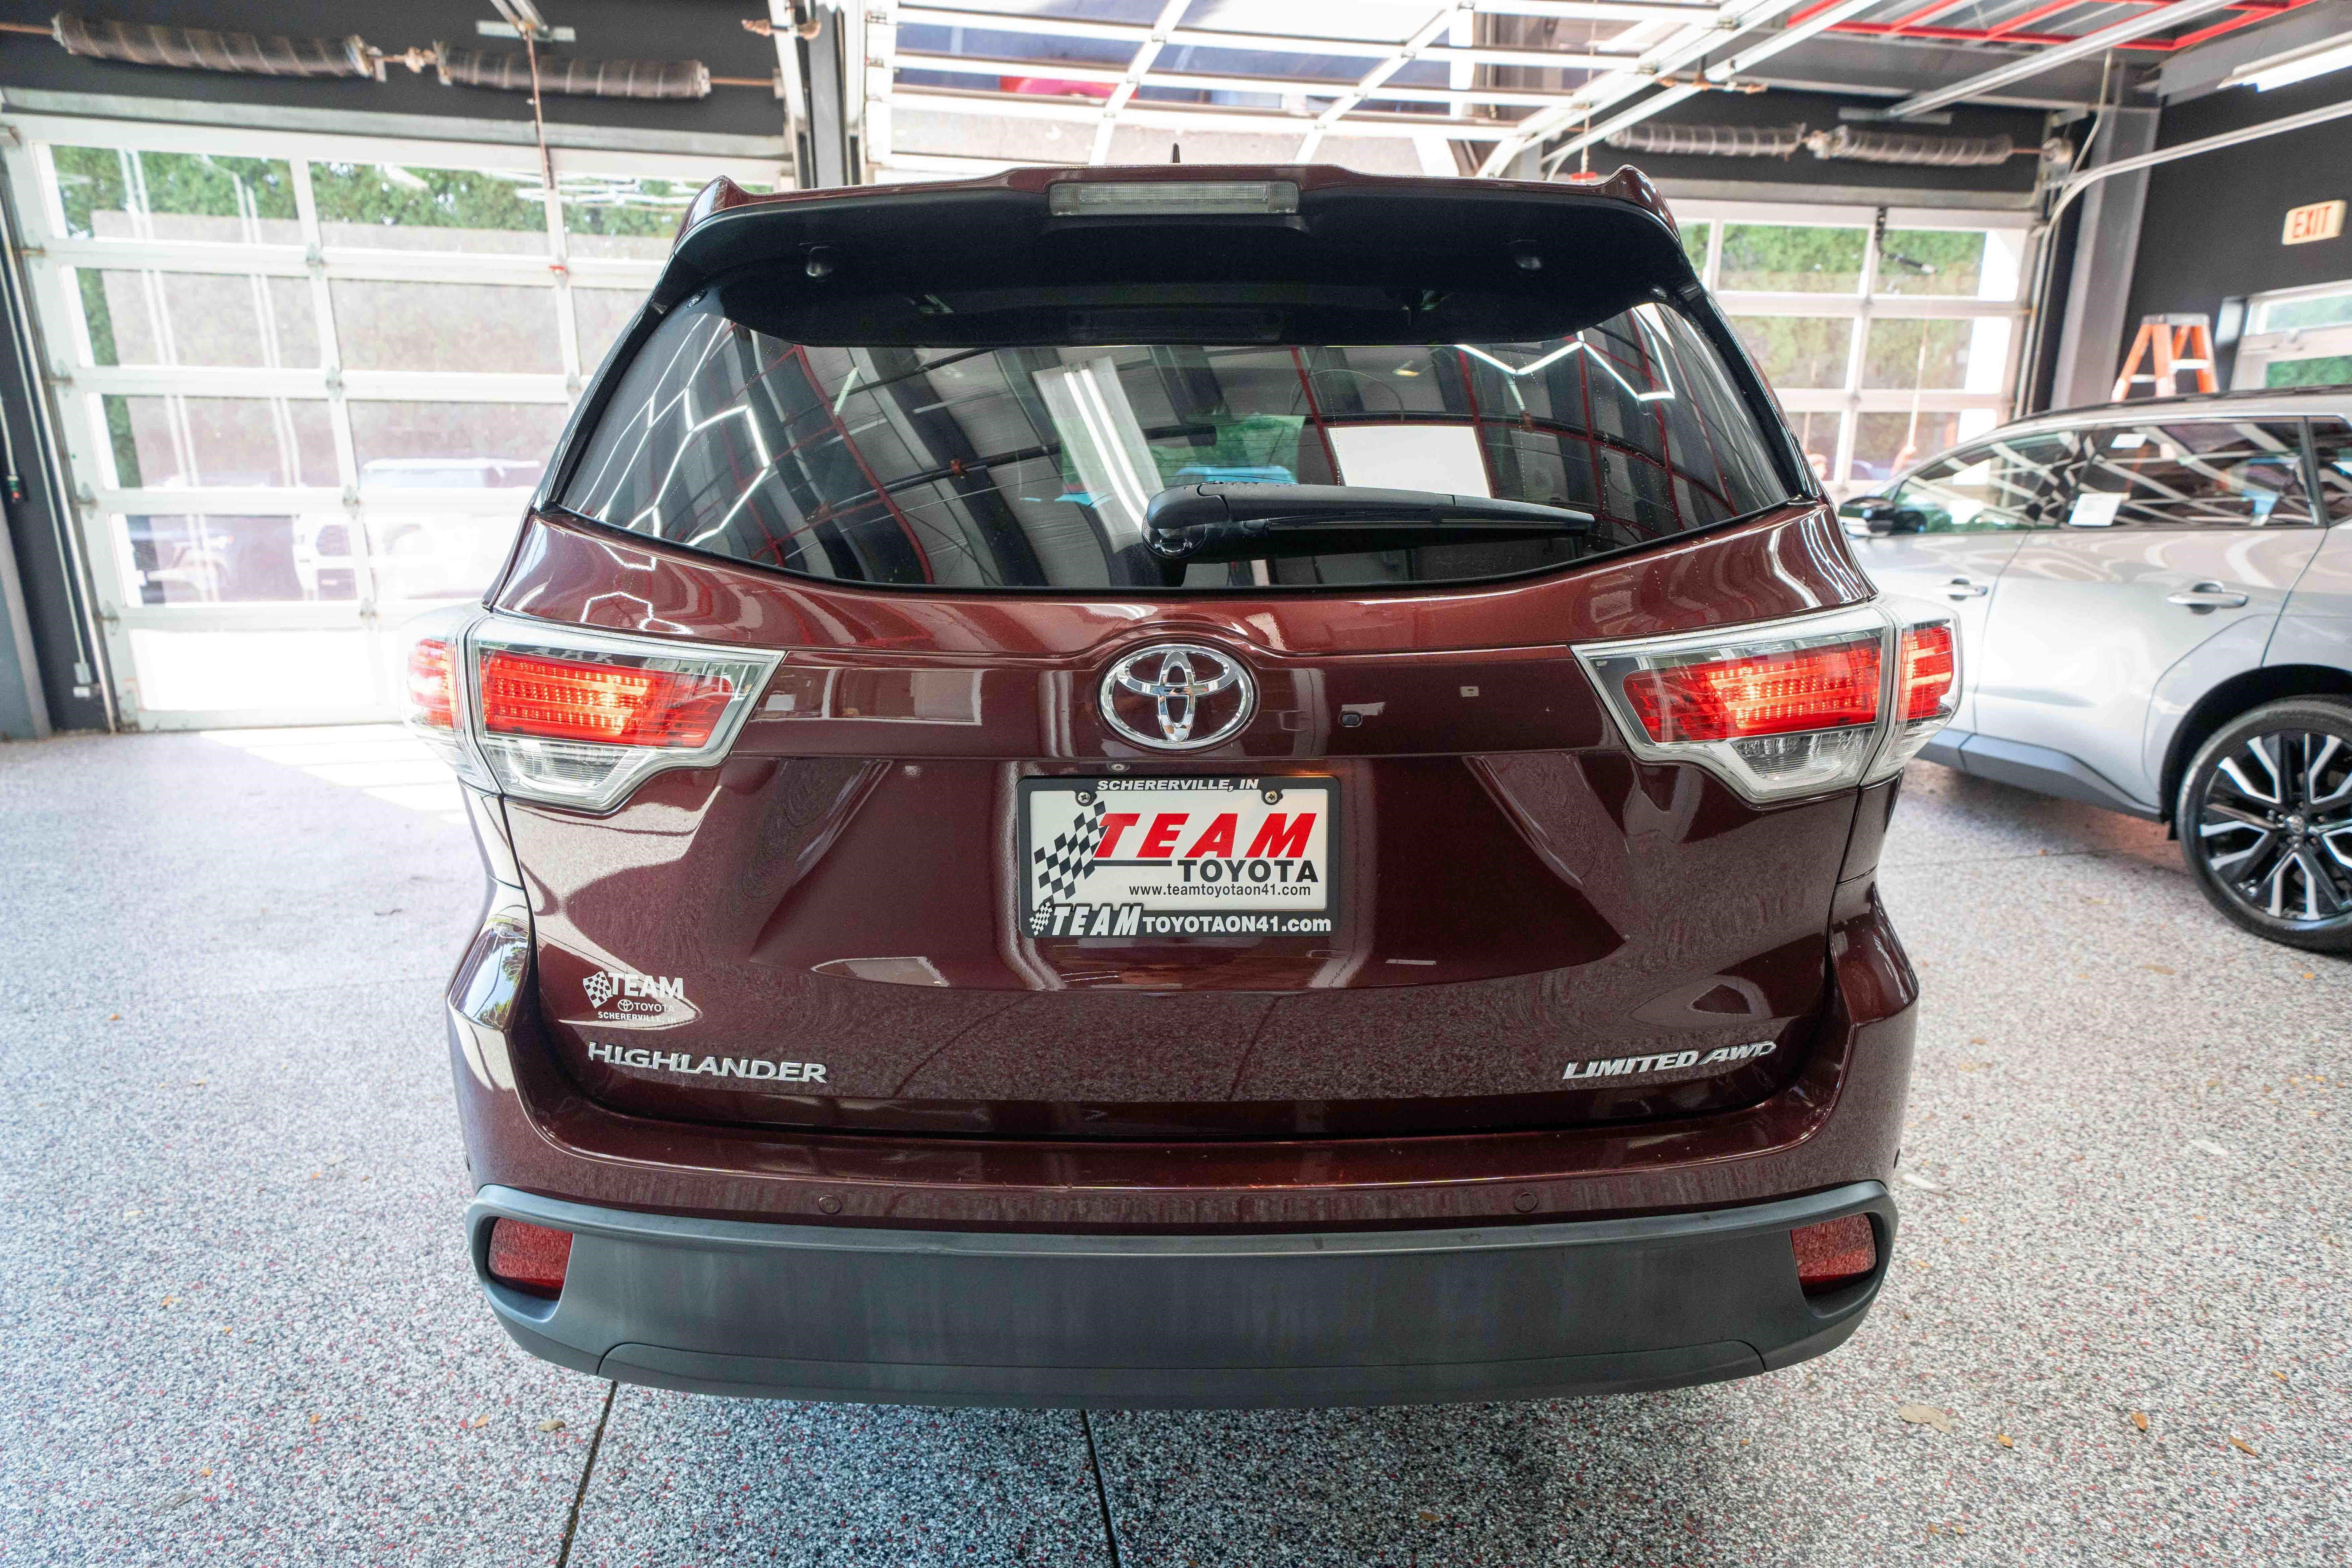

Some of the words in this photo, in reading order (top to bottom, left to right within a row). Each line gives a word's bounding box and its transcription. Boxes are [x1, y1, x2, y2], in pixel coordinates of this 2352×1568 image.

[2292, 206, 2332, 238] EXIT
[1097, 780, 1234, 791] SCHERERVILLE,
[1239, 779, 1259, 790] IN
[1093, 813, 1317, 858] TEAM
[1177, 860, 1319, 883] TOYOTA
[1129, 883, 1311, 898] www.teamtoyotaon41.com
[1051, 906, 1143, 936] TEAM
[1143, 915, 1331, 932] TOYOTAON41.com
[608, 972, 684, 1000] TEAM
[597, 1011, 665, 1023] SCHERERVILLE,
[634, 1002, 675, 1012] TOYOTA
[588, 1041, 827, 1083] HIGHLANDER
[1562, 1050, 1699, 1079] LIMITED
[1698, 1040, 1776, 1065] AWD
